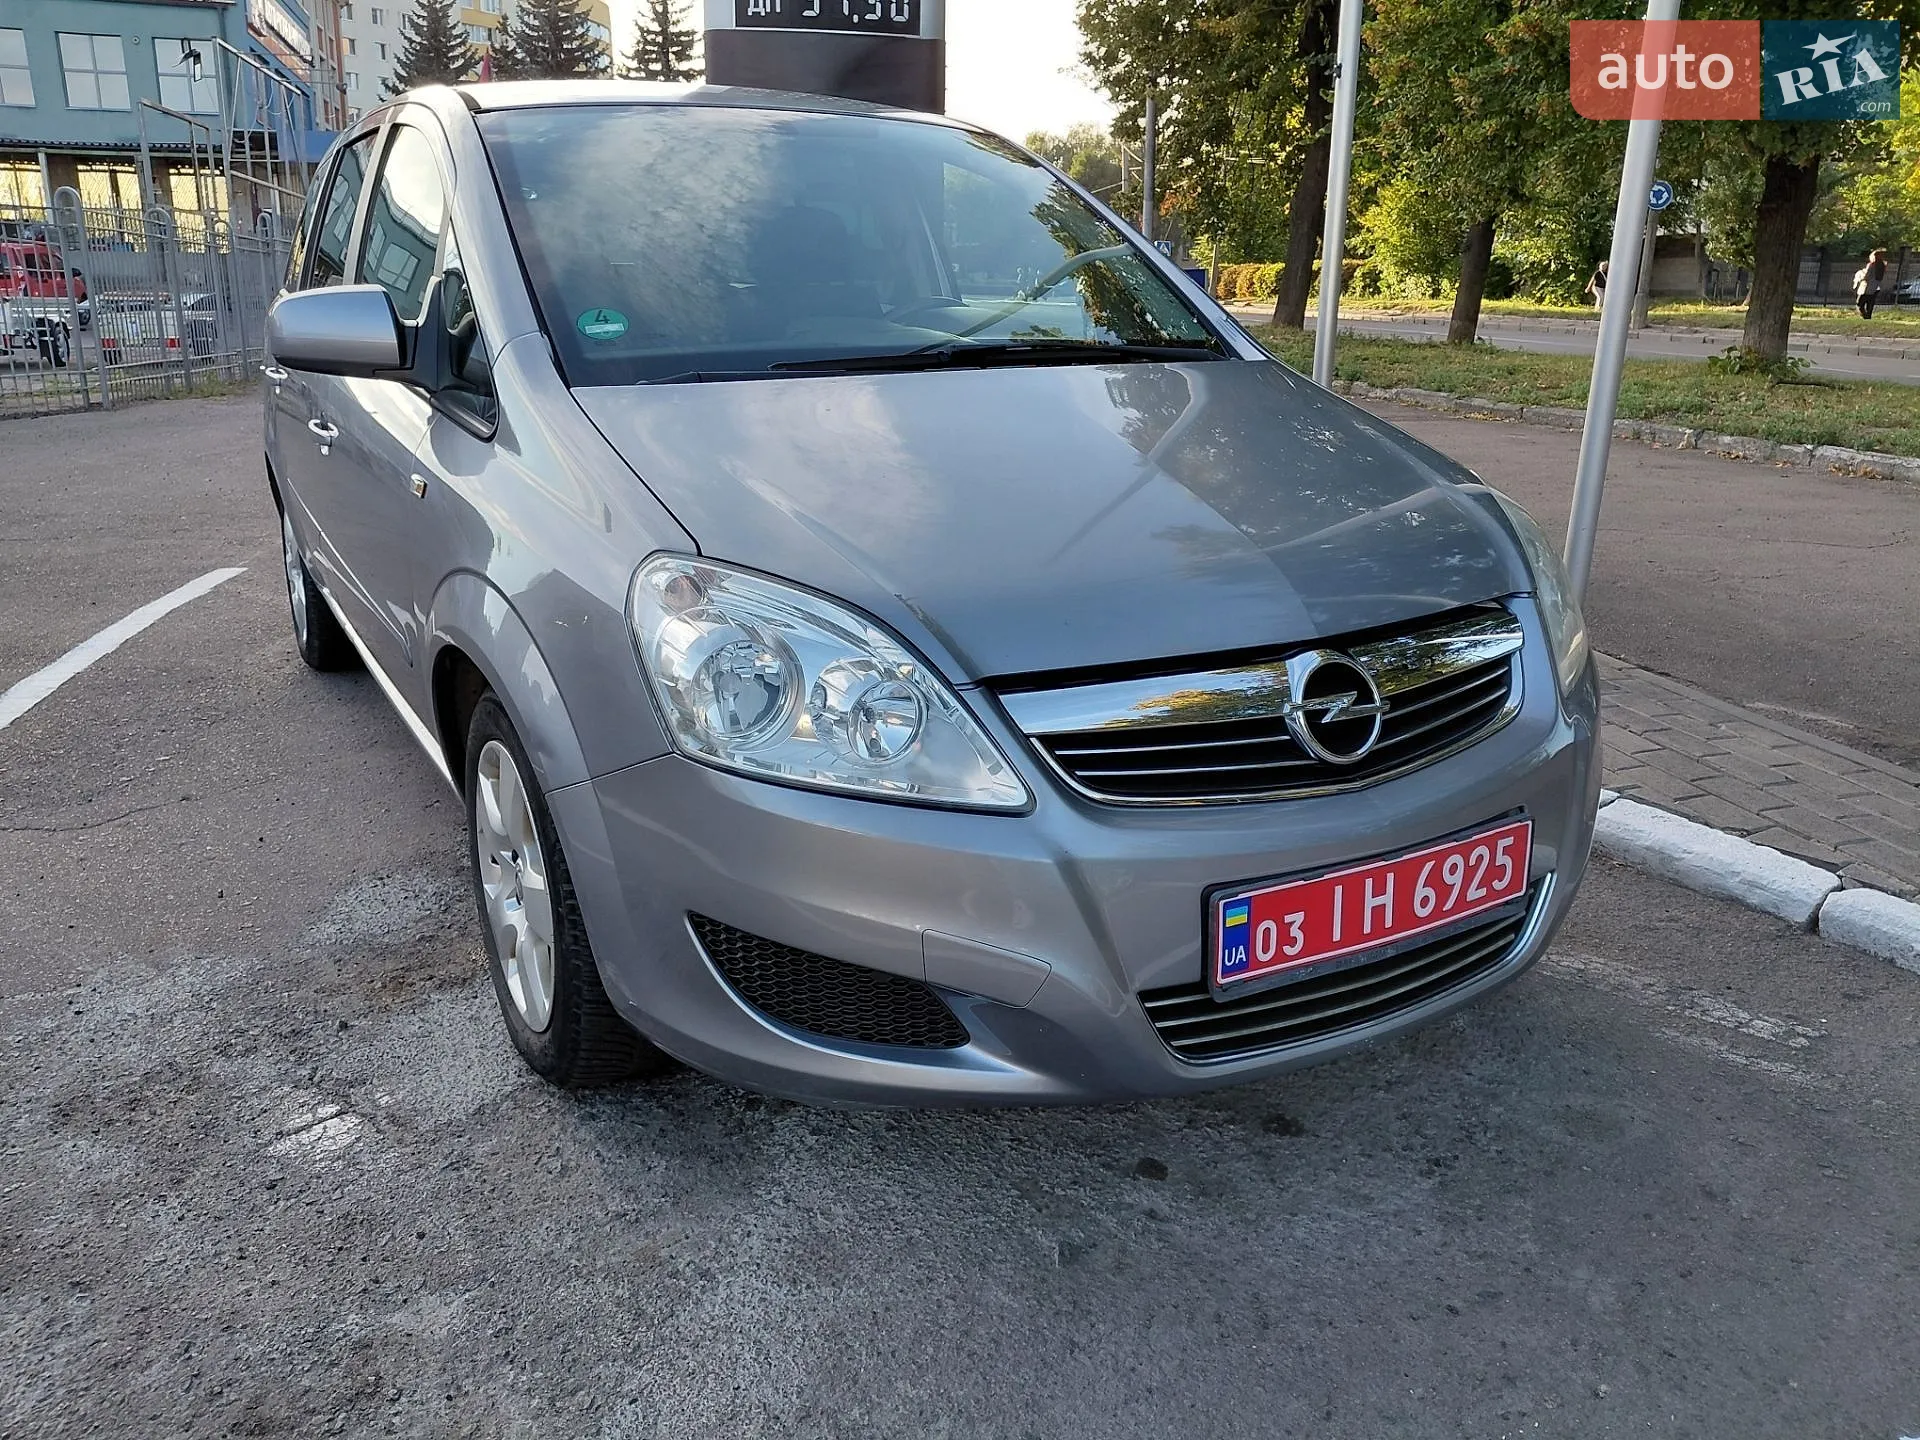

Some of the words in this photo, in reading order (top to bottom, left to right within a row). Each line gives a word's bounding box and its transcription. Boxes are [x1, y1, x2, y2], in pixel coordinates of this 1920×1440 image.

[595, 310, 610, 324] 4
[1255, 911, 1305, 962] 03
[1332, 872, 1394, 942] IH
[1413, 836, 1515, 918] 6925
[1224, 946, 1247, 966] UA
